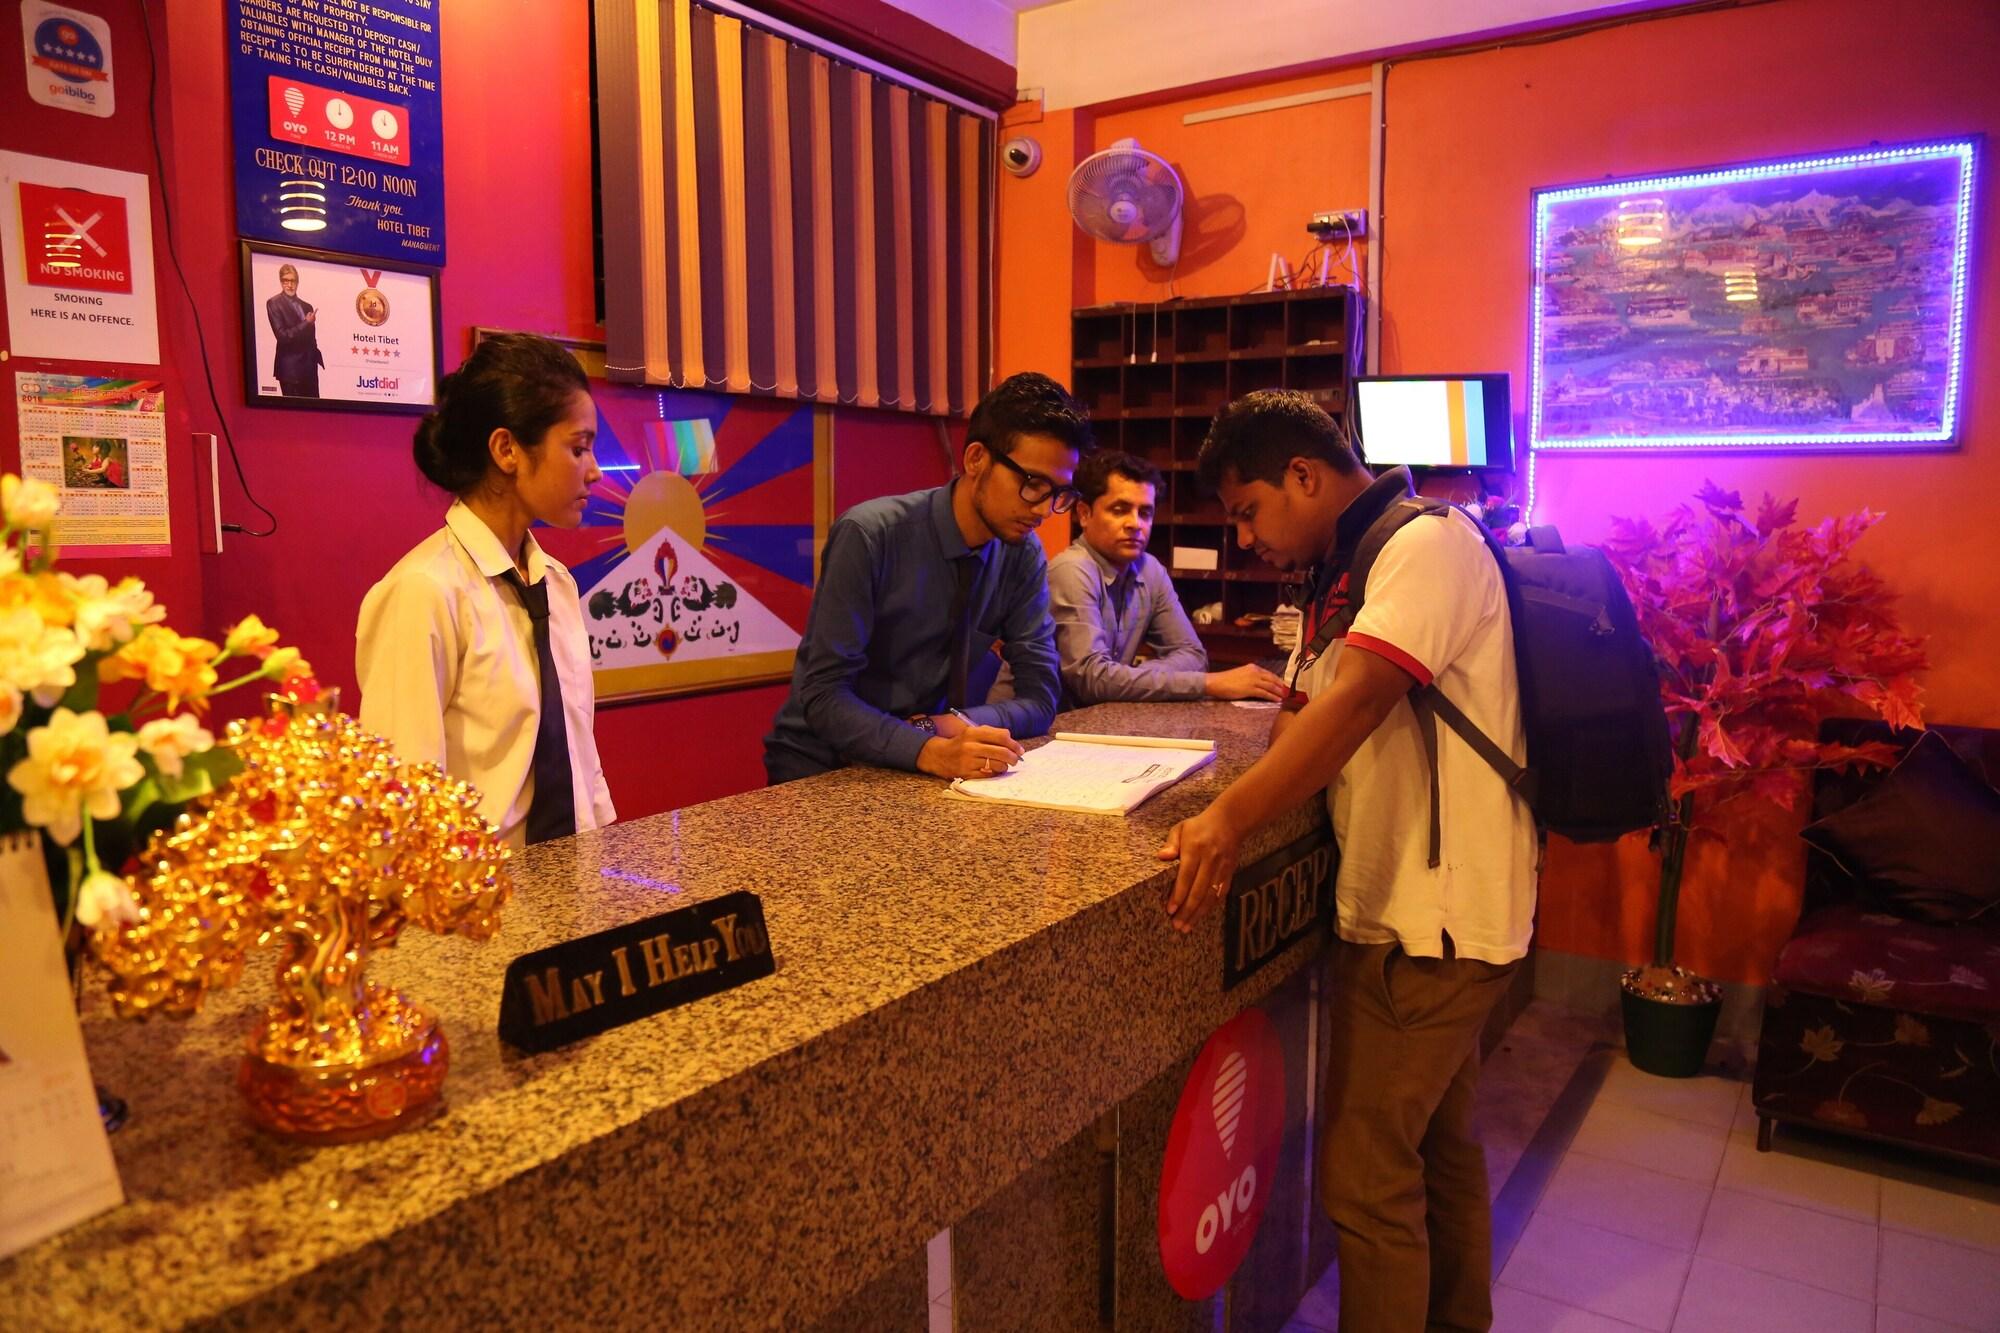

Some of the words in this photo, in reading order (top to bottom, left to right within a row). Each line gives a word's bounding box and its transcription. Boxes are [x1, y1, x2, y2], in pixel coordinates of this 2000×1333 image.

[302, 0, 319, 10] ANY
[324, 4, 368, 26] PROPERTY.
[416, 0, 431, 9] STAY
[241, 0, 282, 13] ARDERS
[286, 6, 301, 18] ARE
[304, 11, 348, 32] REQUESTED
[352, 25, 362, 35] TO
[364, 29, 395, 46] DEPOSIT
[398, 39, 420, 54] CASH/
[341, 0, 357, 10] NOT
[360, 4, 370, 14] BE
[372, 8, 418, 29] RESPONSIBLE
[420, 22, 432, 32] FOR
[240, 5, 288, 27] VALUABLES
[292, 20, 313, 34] WITH
[317, 27, 354, 46] MANAGER
[358, 40, 367, 49] OF
[370, 43, 386, 55] THE
[389, 48, 412, 62] HOTEL
[415, 56, 432, 68] DULY
[240, 18, 285, 38] OBTAINING
[288, 31, 322, 49] OFFICIAL
[324, 42, 356, 57] RECEIPT
[360, 51, 380, 64] FROM
[383, 58, 400, 70] HIM.
[400, 62, 414, 74] THE
[240, 31, 277, 48] RECEIPT
[281, 42, 290, 53] IS
[294, 45, 308, 57] TO
[311, 50, 323, 61] BE
[325, 54, 384, 78] SURRENDERED
[387, 71, 397, 80] AT
[400, 74, 416, 86] THE
[418, 78, 436, 92] TIME
[241, 44, 253, 55] OF
[257, 47, 291, 65] TAKING
[294, 57, 312, 71] THE
[388, 82, 412, 97] BACK.
[49, 84, 95, 100] goibibo
[284, 121, 308, 134] OYO
[324, 130, 336, 141] 12
[339, 133, 356, 145] PM
[371, 141, 381, 150] 11
[382, 143, 399, 155] AM
[255, 148, 304, 175] CHECK
[309, 158, 337, 181] OUT
[382, 175, 417, 197] NOON
[344, 195, 380, 211] Thank
[382, 205, 403, 217] you
[377, 219, 405, 235] HOTEL
[408, 224, 430, 238] TIBET
[40, 263, 60, 274] NO
[64, 266, 125, 282] SMOKING
[54, 293, 103, 305] SMOKING
[30, 308, 56, 319] HERE
[72, 313, 86, 321] AN
[88, 314, 135, 326] OFFENCE.
[353, 333, 376, 343] Hotel
[378, 335, 399, 345] Tibet
[357, 375, 399, 389] Justdial
[1235, 845, 1336, 972] RECEP
[612, 947, 637, 996] I
[640, 933, 720, 987] HELP
[1195, 1164, 1256, 1255] OYO
